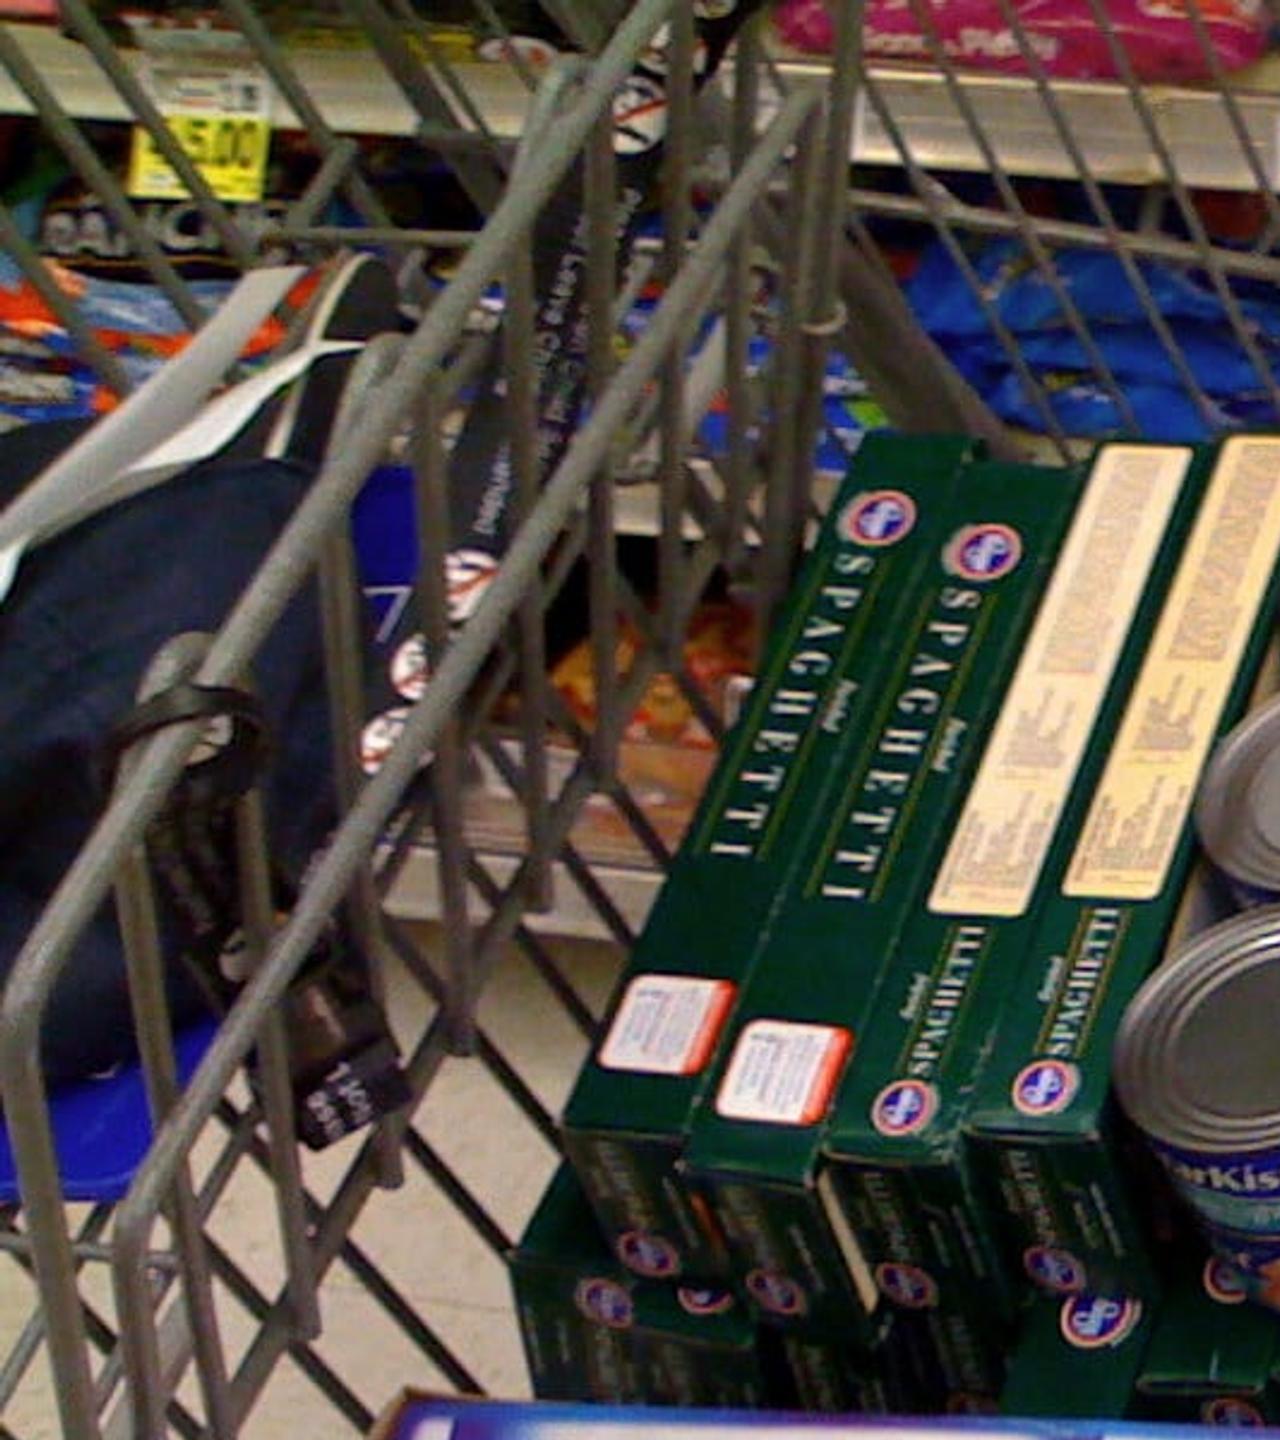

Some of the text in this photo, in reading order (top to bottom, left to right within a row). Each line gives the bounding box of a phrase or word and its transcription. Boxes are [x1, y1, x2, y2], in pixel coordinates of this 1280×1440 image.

[709, 552, 877, 858] SPAGHETTI
[822, 588, 982, 900] SPAGHETTI
[911, 924, 987, 1077] SPAGHETTI
[1047, 907, 1122, 1057] SPAGHETTI
